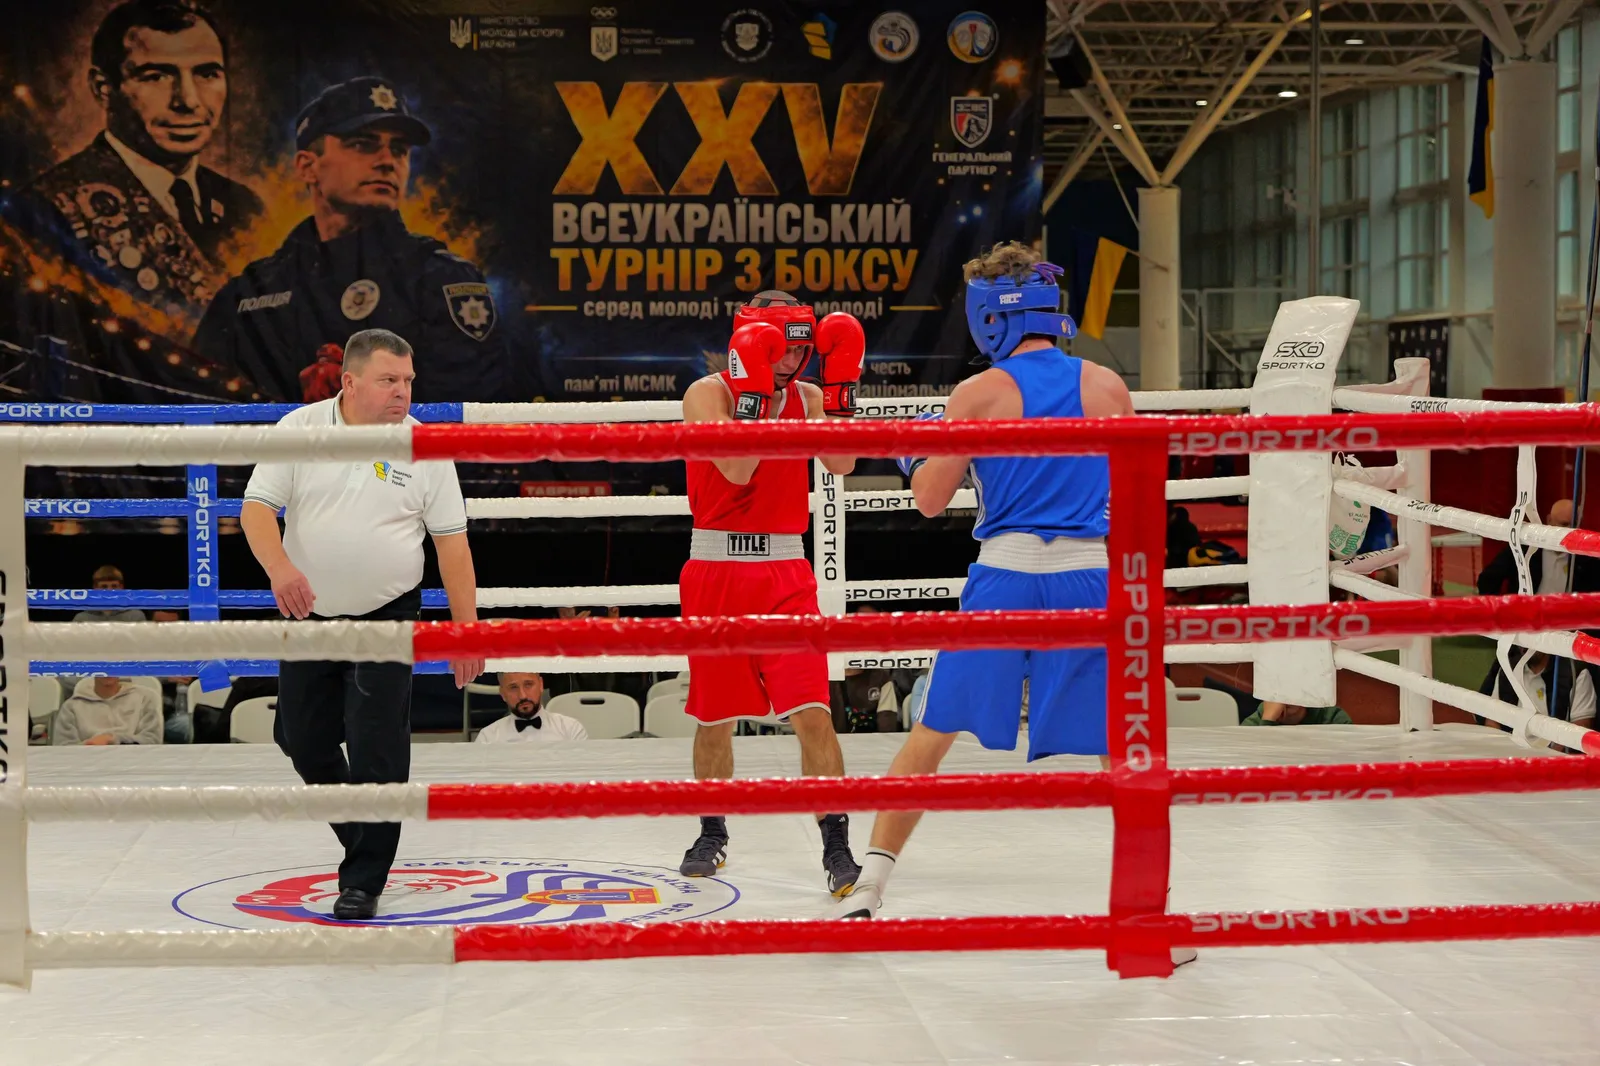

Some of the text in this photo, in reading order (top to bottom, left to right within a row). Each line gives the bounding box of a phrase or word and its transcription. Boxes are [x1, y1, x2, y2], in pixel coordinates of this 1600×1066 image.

[551, 81, 884, 196] XXV
[932, 151, 1012, 162] ГЕНЕРАЛЬНИЙ
[948, 165, 997, 175] ПАРТНЕР
[552, 197, 911, 243] ВСЕУКРАЇНСЬКИЙ
[550, 247, 919, 292] ТУРНІР З БОКСУ
[584, 300, 644, 320] серед
[650, 297, 719, 320] молоді
[1273, 341, 1325, 358] SKO
[870, 362, 911, 375] честь
[1261, 362, 1325, 370] SPORTKO
[624, 374, 676, 392] МСМК
[1410, 400, 1448, 413] SPORTKO
[195, 477, 211, 587] SPORTKO
[822, 472, 837, 581] SPORTKO
[730, 535, 766, 551] TITLE
[848, 657, 933, 669] SPORT
[1123, 551, 1151, 772] SPORTKO
[1191, 907, 1410, 932] SPORTKO
